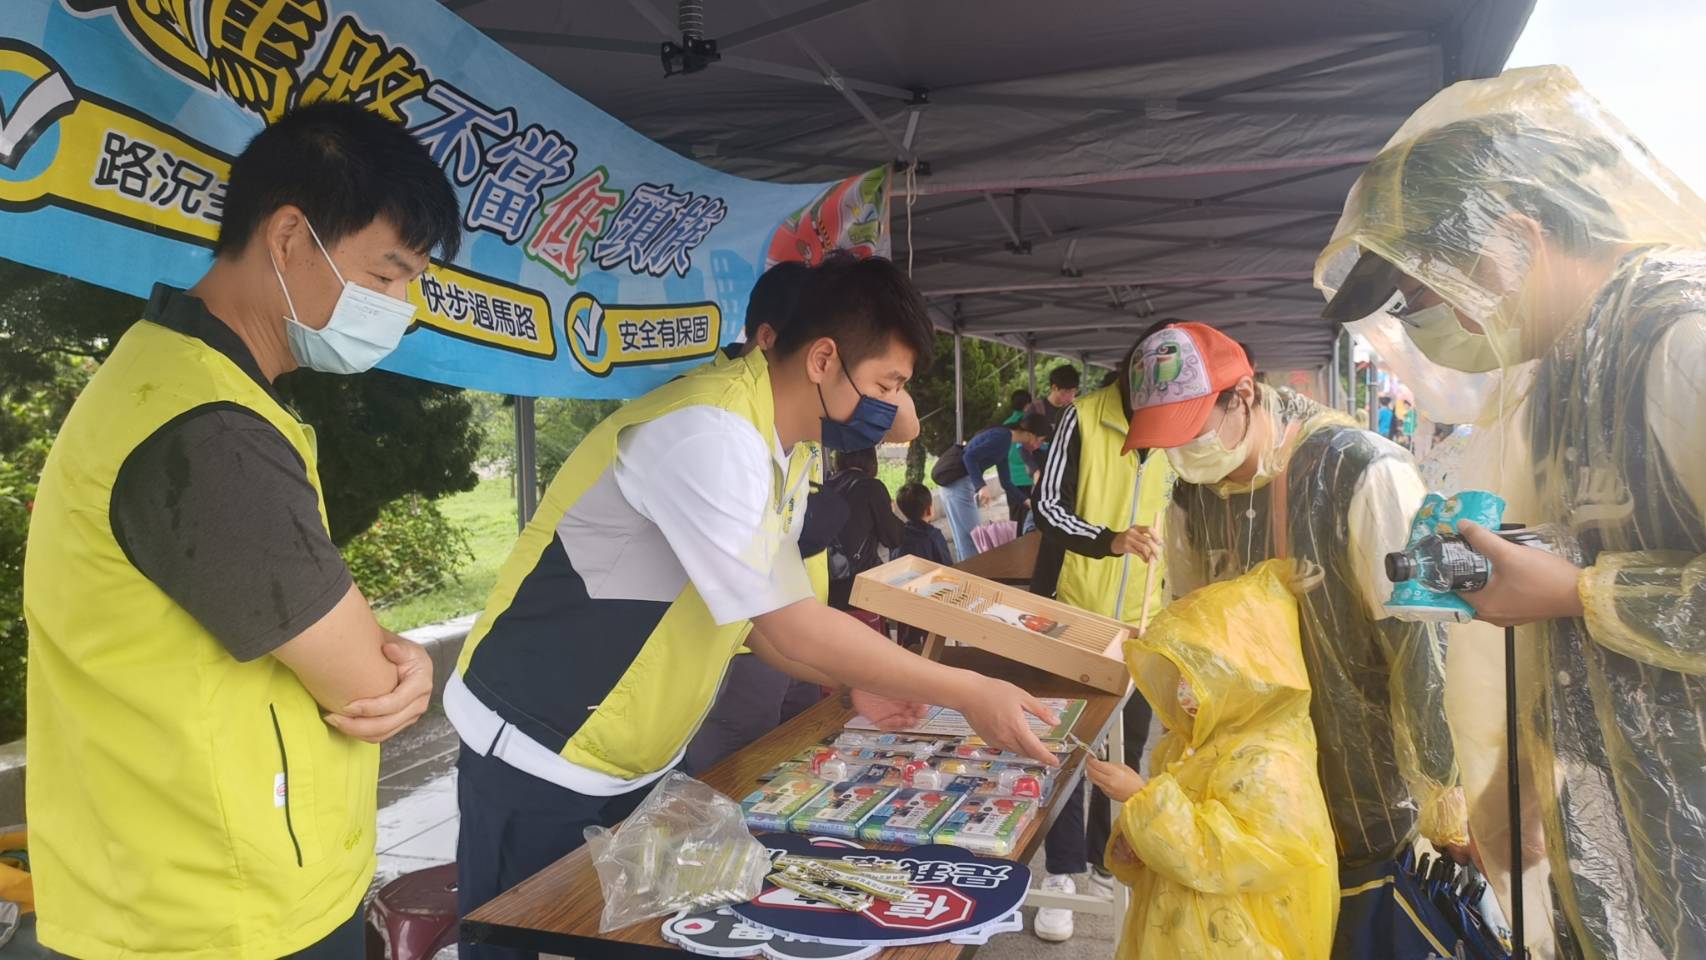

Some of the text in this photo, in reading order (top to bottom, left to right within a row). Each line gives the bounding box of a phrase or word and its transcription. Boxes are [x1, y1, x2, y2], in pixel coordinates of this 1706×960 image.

[420, 273, 538, 340] 快步過馬路
[618, 314, 710, 352] 安全有保固
